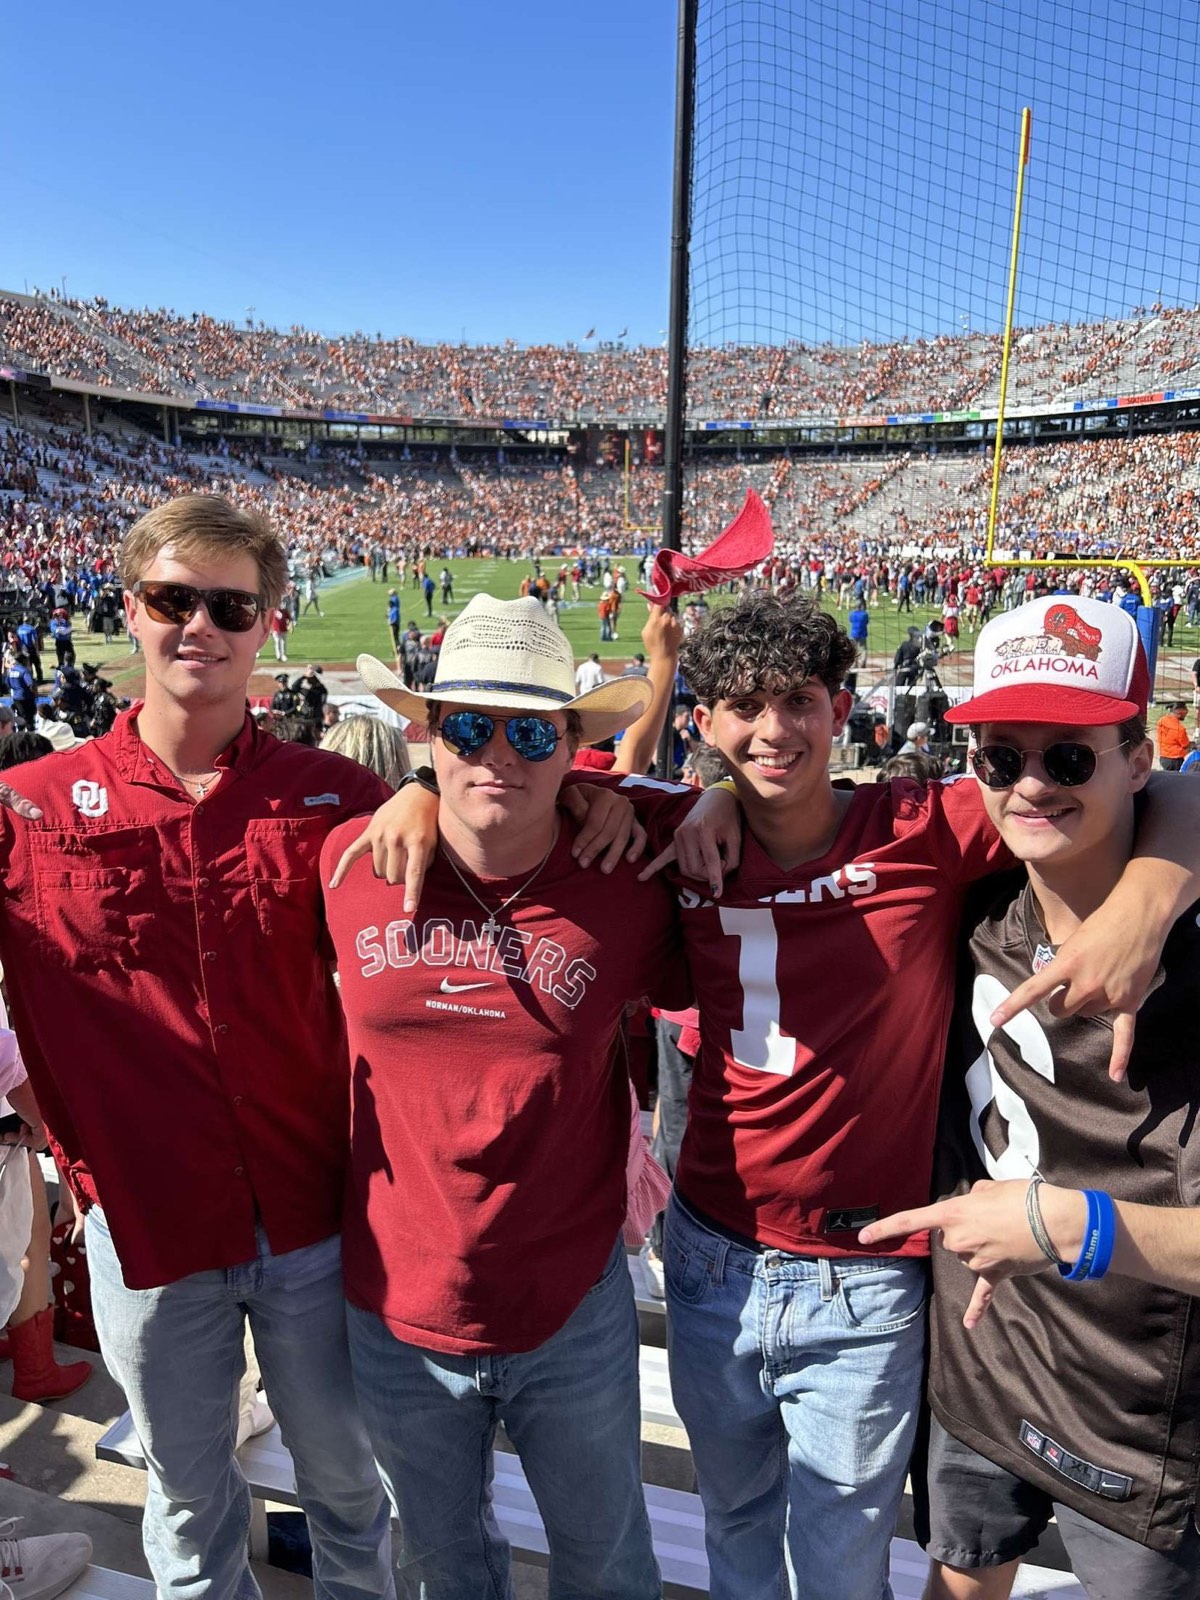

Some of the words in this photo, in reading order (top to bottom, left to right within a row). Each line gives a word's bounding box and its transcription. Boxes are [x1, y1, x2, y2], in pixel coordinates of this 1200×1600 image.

[991, 658, 1099, 680] OKLAHOMA
[356, 918, 597, 1008] SOONERS
[719, 907, 796, 1077] 1
[425, 999, 507, 1019] NORMAN/OKLAHOMA
[1084, 1229, 1099, 1261] Name
